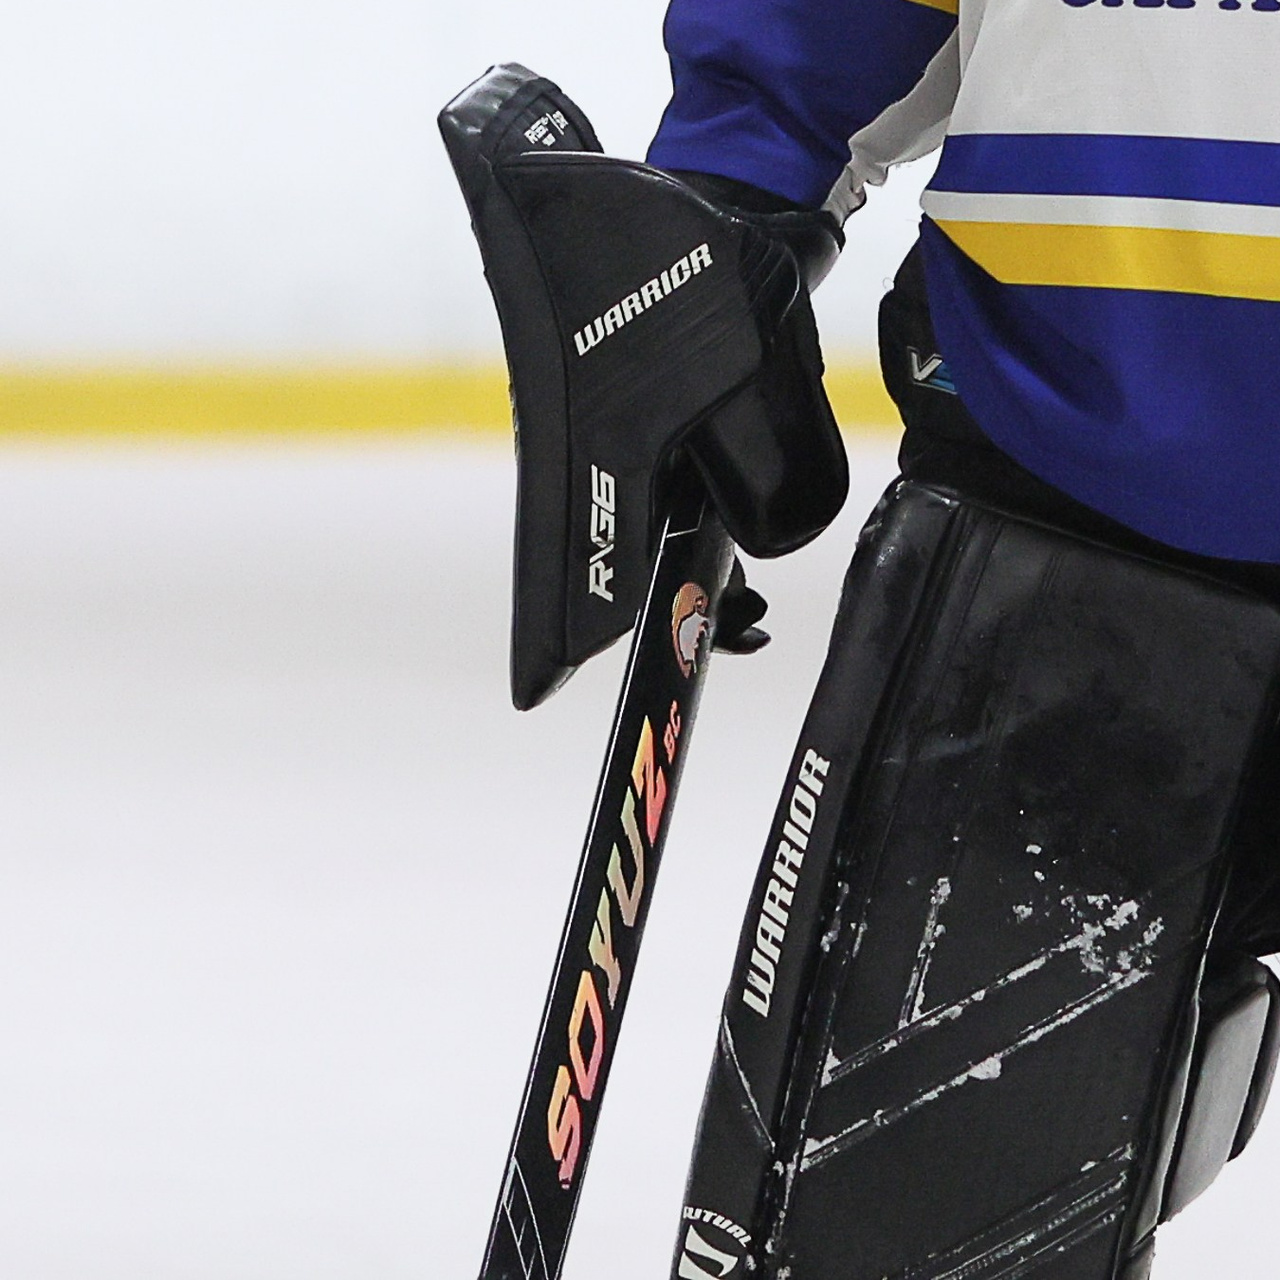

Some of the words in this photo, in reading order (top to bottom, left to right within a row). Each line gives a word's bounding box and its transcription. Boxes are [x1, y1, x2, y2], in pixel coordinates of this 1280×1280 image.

[573, 243, 713, 356] WARRIOR
[547, 714, 667, 1189] SOYUZ
[742, 748, 830, 1017] WARRIOR
